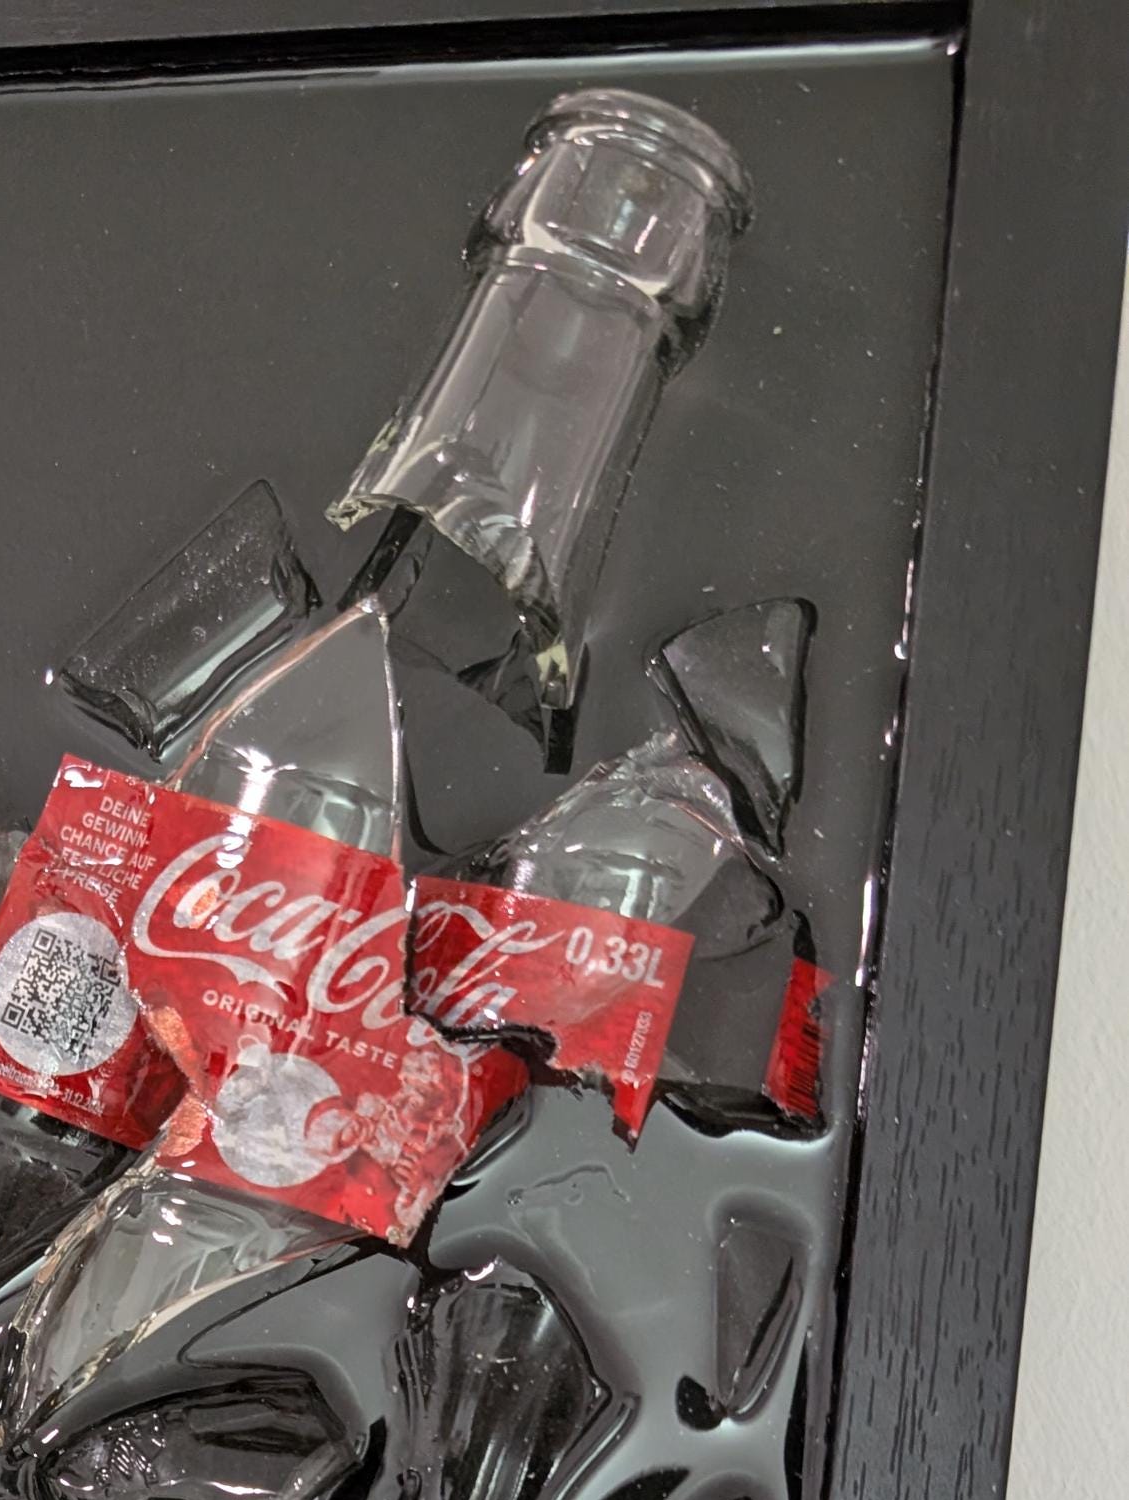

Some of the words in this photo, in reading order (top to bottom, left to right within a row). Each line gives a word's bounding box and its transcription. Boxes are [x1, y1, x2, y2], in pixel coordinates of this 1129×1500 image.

[82, 812, 150, 848] GEWINN-
[100, 796, 151, 828] DEINE
[60, 825, 128, 860] CHANCE
[127, 852, 157, 871] AUF
[133, 832, 565, 1054] Coca-Cola
[565, 926, 665, 989] 0,33L
[202, 989, 314, 1041] ORIGINAL
[325, 1030, 399, 1070] TASTE
